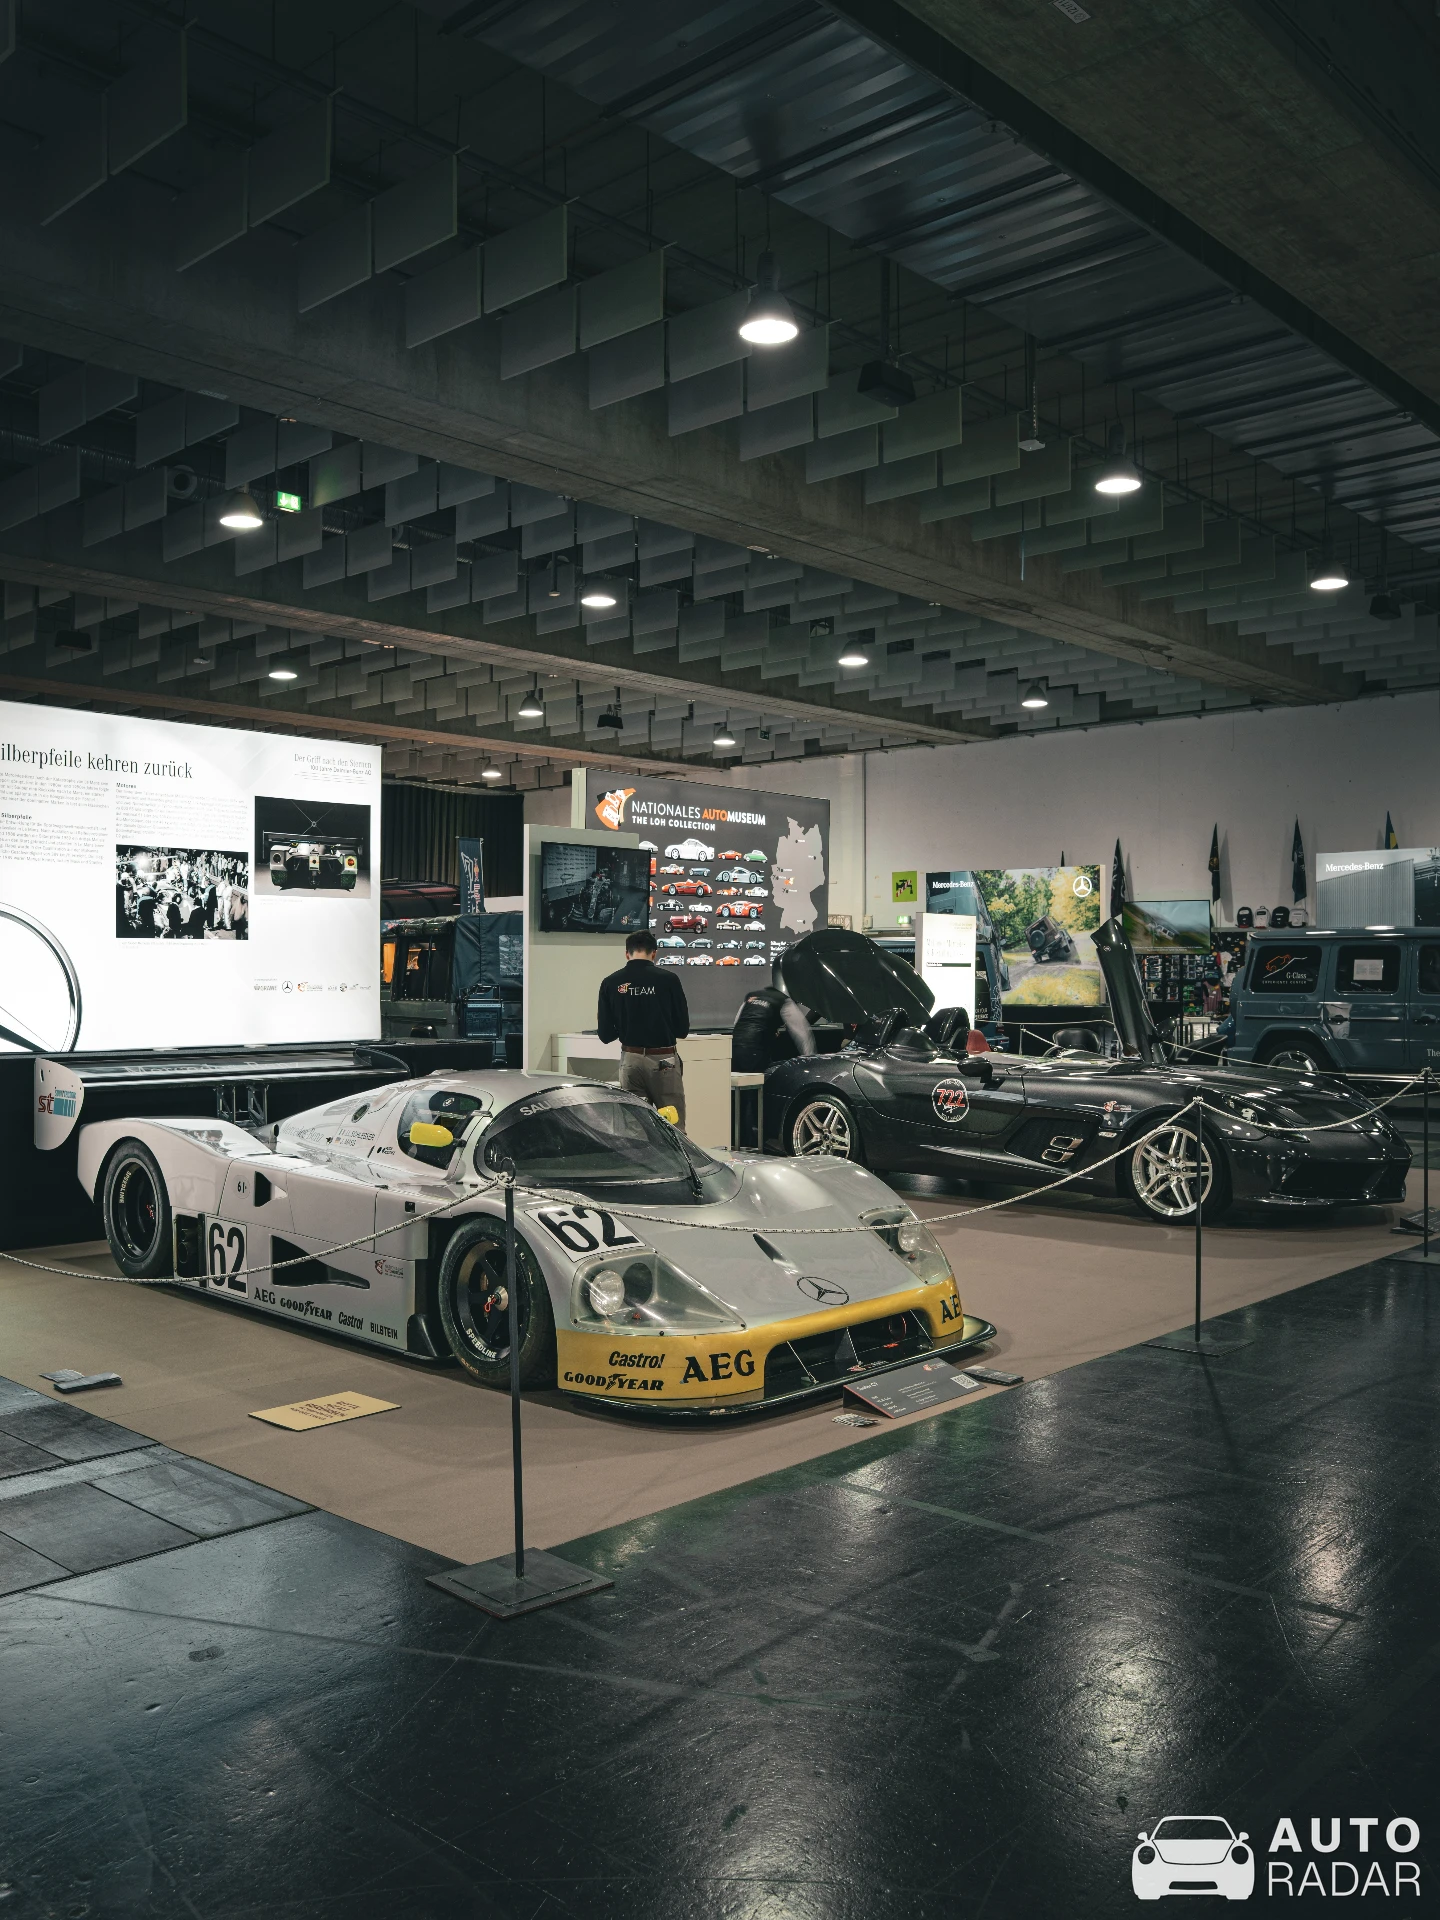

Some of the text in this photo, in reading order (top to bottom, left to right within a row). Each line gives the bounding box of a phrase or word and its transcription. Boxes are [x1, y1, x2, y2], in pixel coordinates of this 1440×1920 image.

[0, 743, 193, 779] ilberpfeile kehren zurück
[294, 753, 306, 763] Der
[306, 754, 321, 764] Griff
[631, 800, 766, 826] NATIONALES AUTOMUSEUM
[632, 815, 716, 832] THE LOH COLLECTION
[1325, 861, 1384, 872] Mercedes-Benz
[932, 881, 975, 889] Mercedes-Benz
[1286, 971, 1307, 980] G-Class
[628, 986, 656, 996] TEAM
[937, 1088, 966, 1107] 722
[537, 1205, 640, 1253] 62
[208, 1222, 247, 1294] 62
[253, 1287, 398, 1340] AEG GOODYEAR Castrol BILSTEIN
[939, 1294, 963, 1324] AE
[466, 1328, 497, 1358] SPEEDLINE
[608, 1350, 666, 1369] Castrol
[679, 1349, 756, 1384] AEG
[563, 1371, 664, 1391] GOODYEAR
